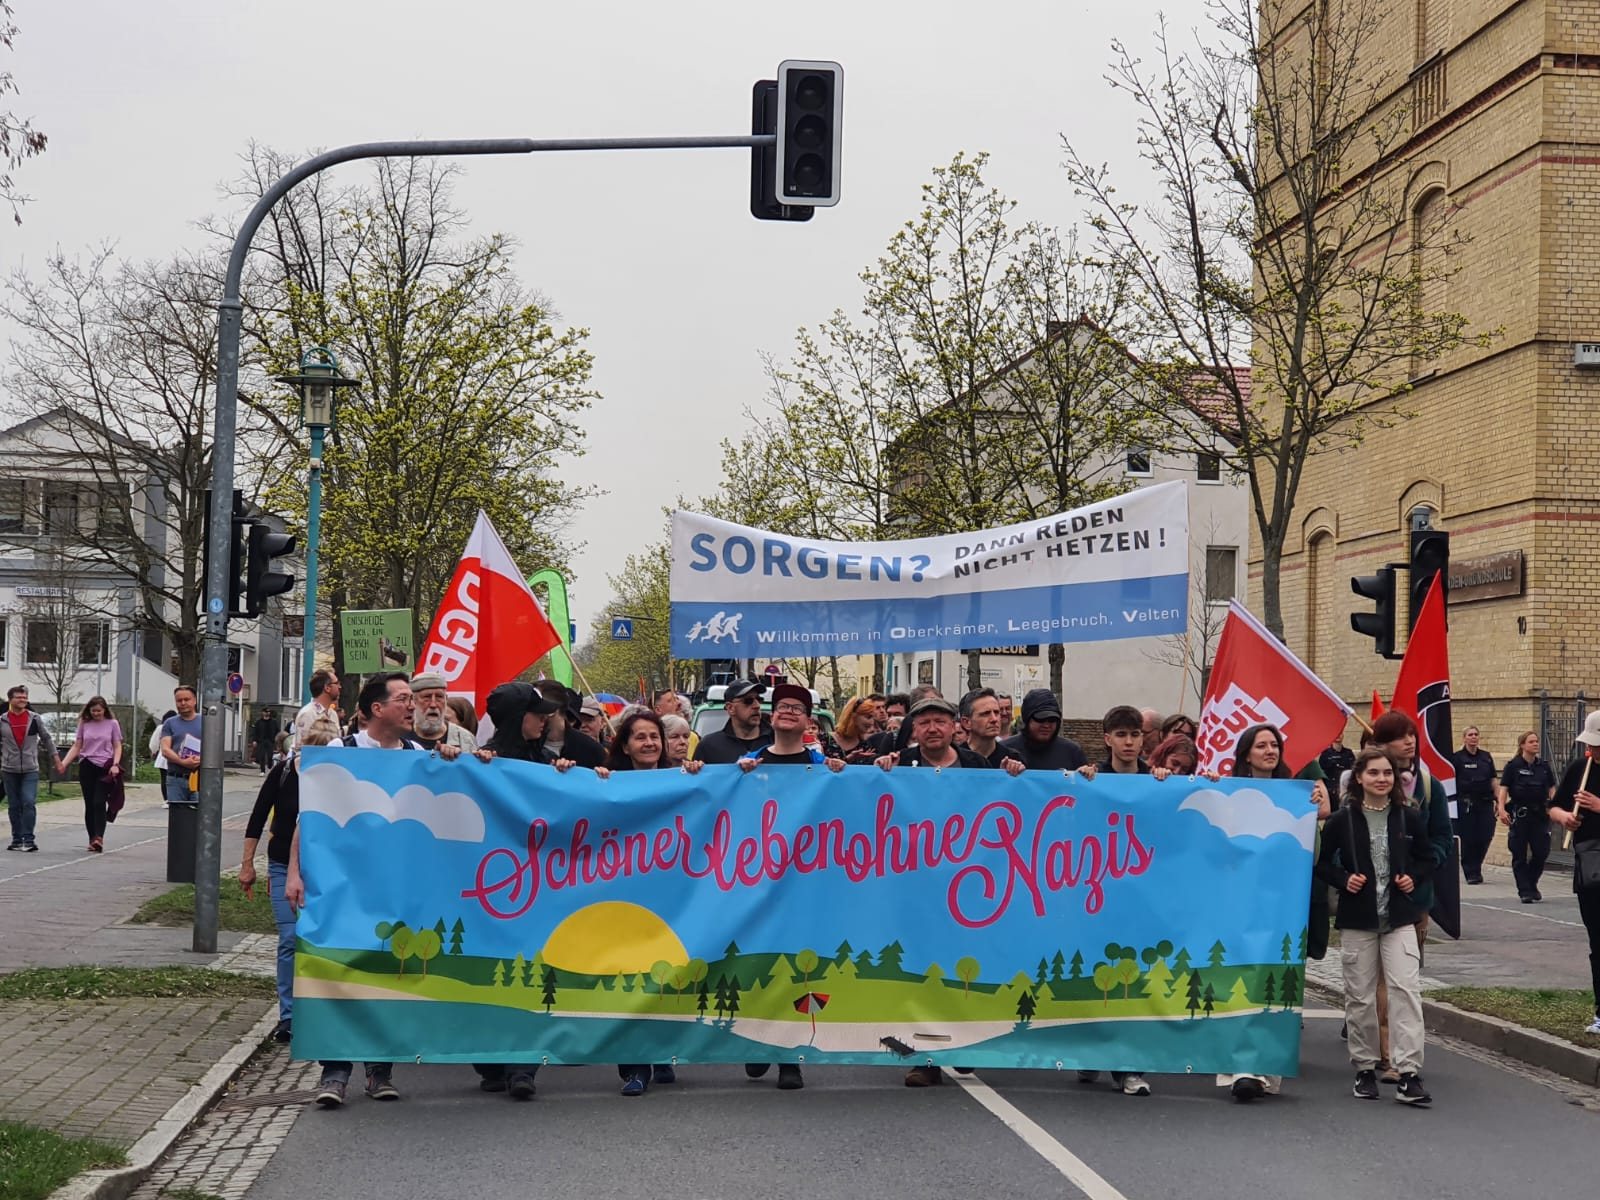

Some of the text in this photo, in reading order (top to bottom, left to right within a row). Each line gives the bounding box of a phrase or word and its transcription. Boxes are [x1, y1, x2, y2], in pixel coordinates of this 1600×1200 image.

[954, 507, 1124, 561] DANN REDEN
[688, 532, 932, 583] SORGEN?
[953, 549, 1036, 578] NICHT
[344, 635, 408, 649] MENSCH ZU
[756, 629, 859, 643] Willkommen
[867, 628, 881, 641] in
[1007, 612, 1114, 633] Leegebruch,
[1121, 607, 1181, 623] Velten
[1517, 615, 1527, 635] 10
[461, 793, 1155, 929] Schöner leben ohne Nazis
